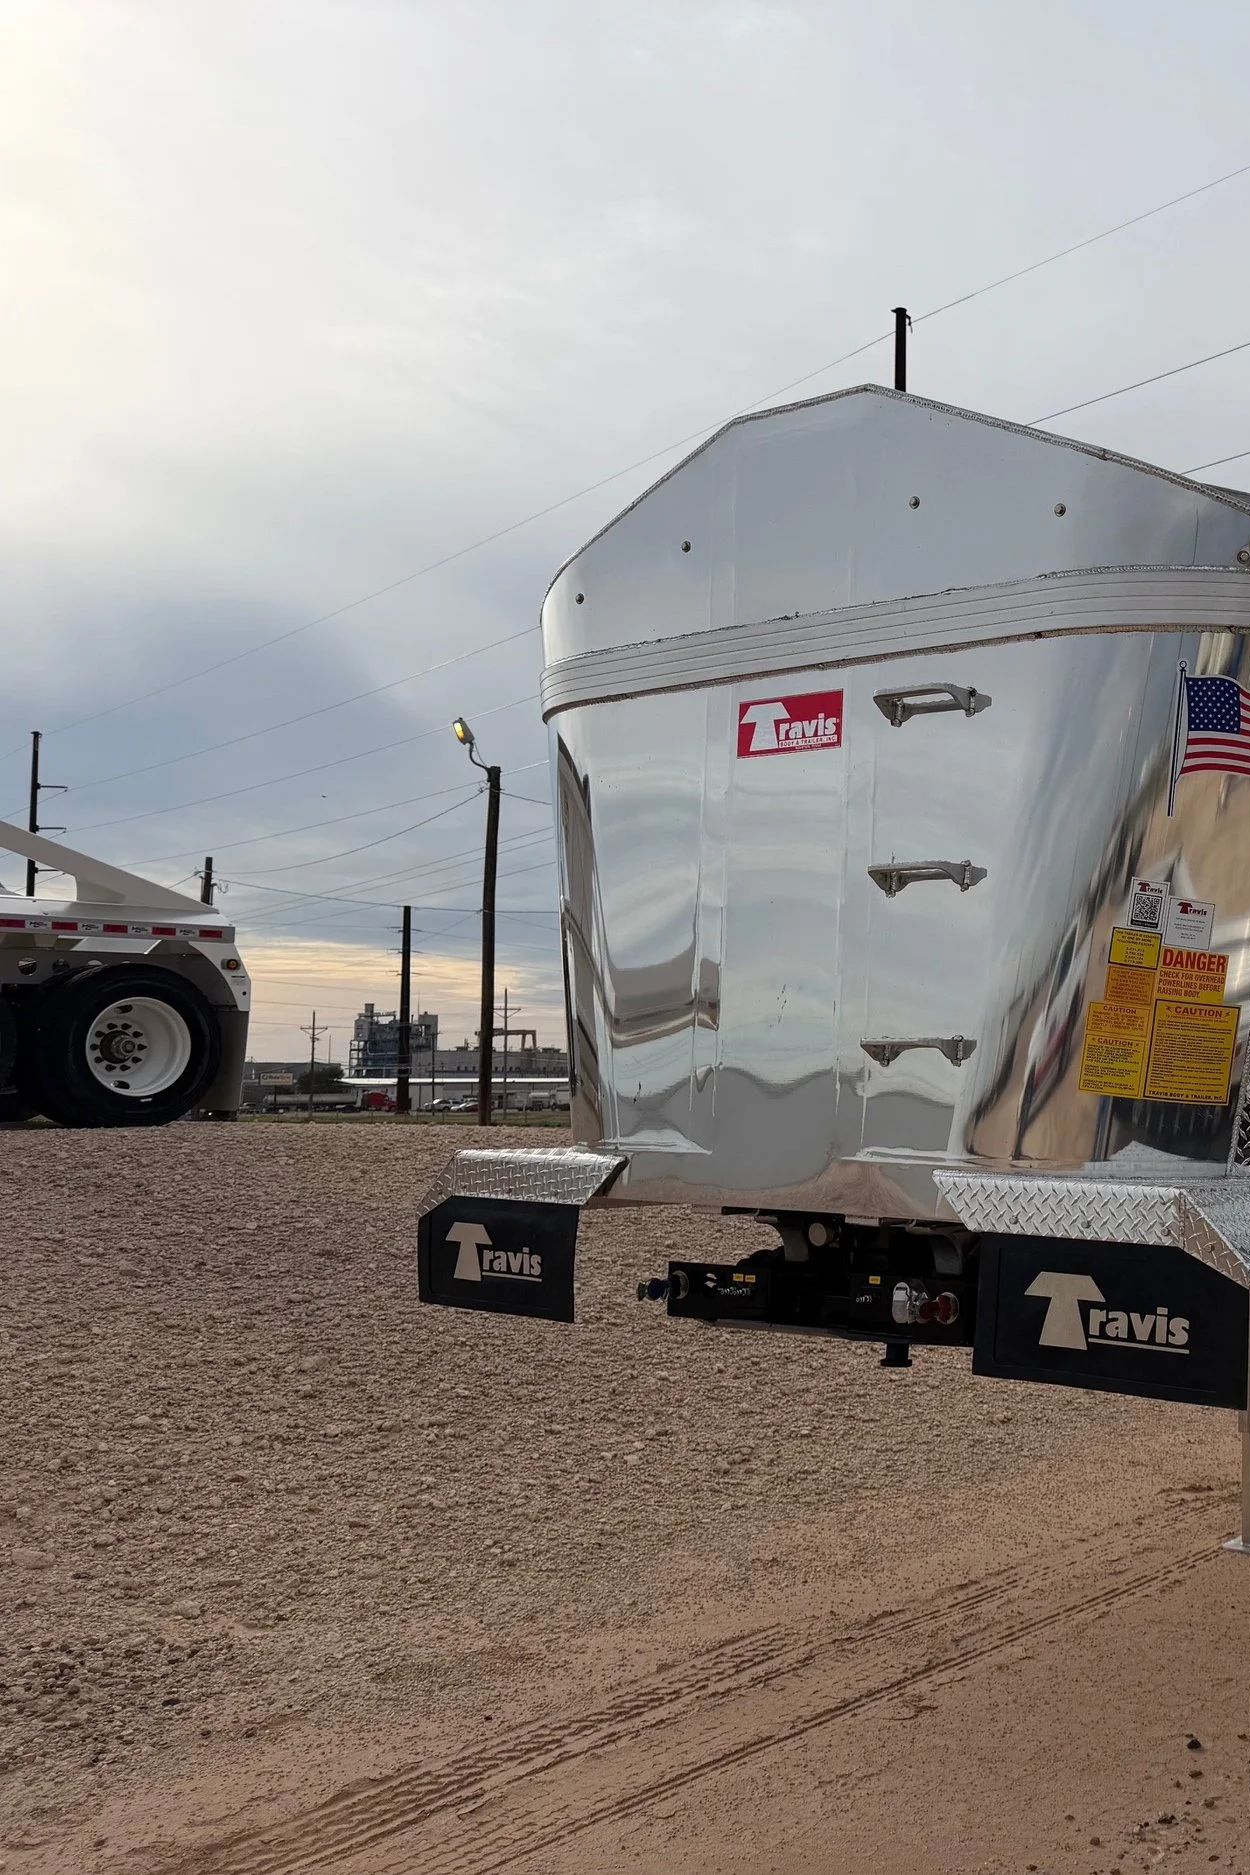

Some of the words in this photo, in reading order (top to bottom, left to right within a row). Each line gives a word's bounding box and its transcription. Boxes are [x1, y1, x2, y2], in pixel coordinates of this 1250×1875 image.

[740, 702, 838, 752] Travis
[1137, 882, 1163, 894] Travis
[1177, 902, 1207, 916] Travis
[1162, 949, 1227, 973] DANGER
[1159, 970, 1180, 979] CHECK
[1180, 972, 1194, 980] FOR
[1194, 974, 1225, 984] OVERHEAD
[1157, 986, 1183, 996] RAISING
[1183, 989, 1200, 998] BODY.
[1158, 978, 1198, 989] POWERLINES
[1198, 983, 1221, 992] BEFORE
[1103, 1005, 1137, 1014] CAUTION
[1174, 1006, 1223, 1018] CAUTION
[1097, 1037, 1133, 1047] CAUTION
[1149, 1090, 1168, 1098] TRAVIS
[445, 1221, 542, 1282] Travis
[1024, 1271, 1190, 1351] Travis
